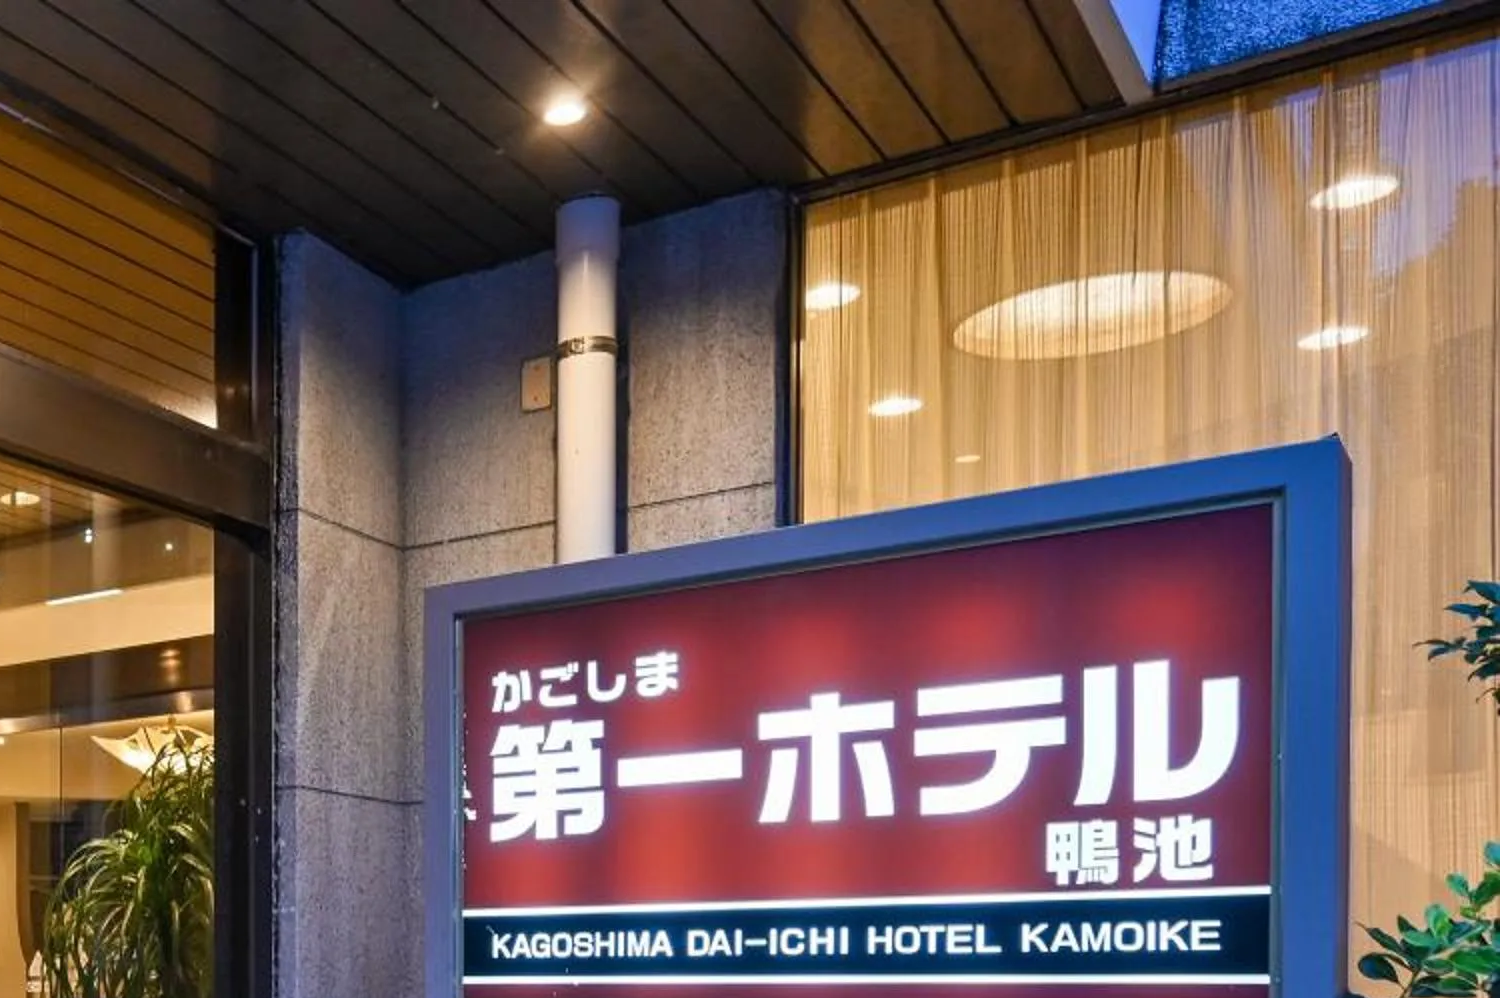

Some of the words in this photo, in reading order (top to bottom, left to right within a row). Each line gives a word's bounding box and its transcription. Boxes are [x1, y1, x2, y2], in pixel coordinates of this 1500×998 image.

[491, 650, 680, 714] かごしま
[489, 660, 1241, 842] 第一ホテル
[1045, 814, 1214, 886] 鴨池
[492, 930, 674, 959] KAGOSHIMA
[687, 926, 849, 957] DAI-ICHI
[867, 923, 1002, 955] HOTEL
[1020, 919, 1222, 953] KAMOIKE
